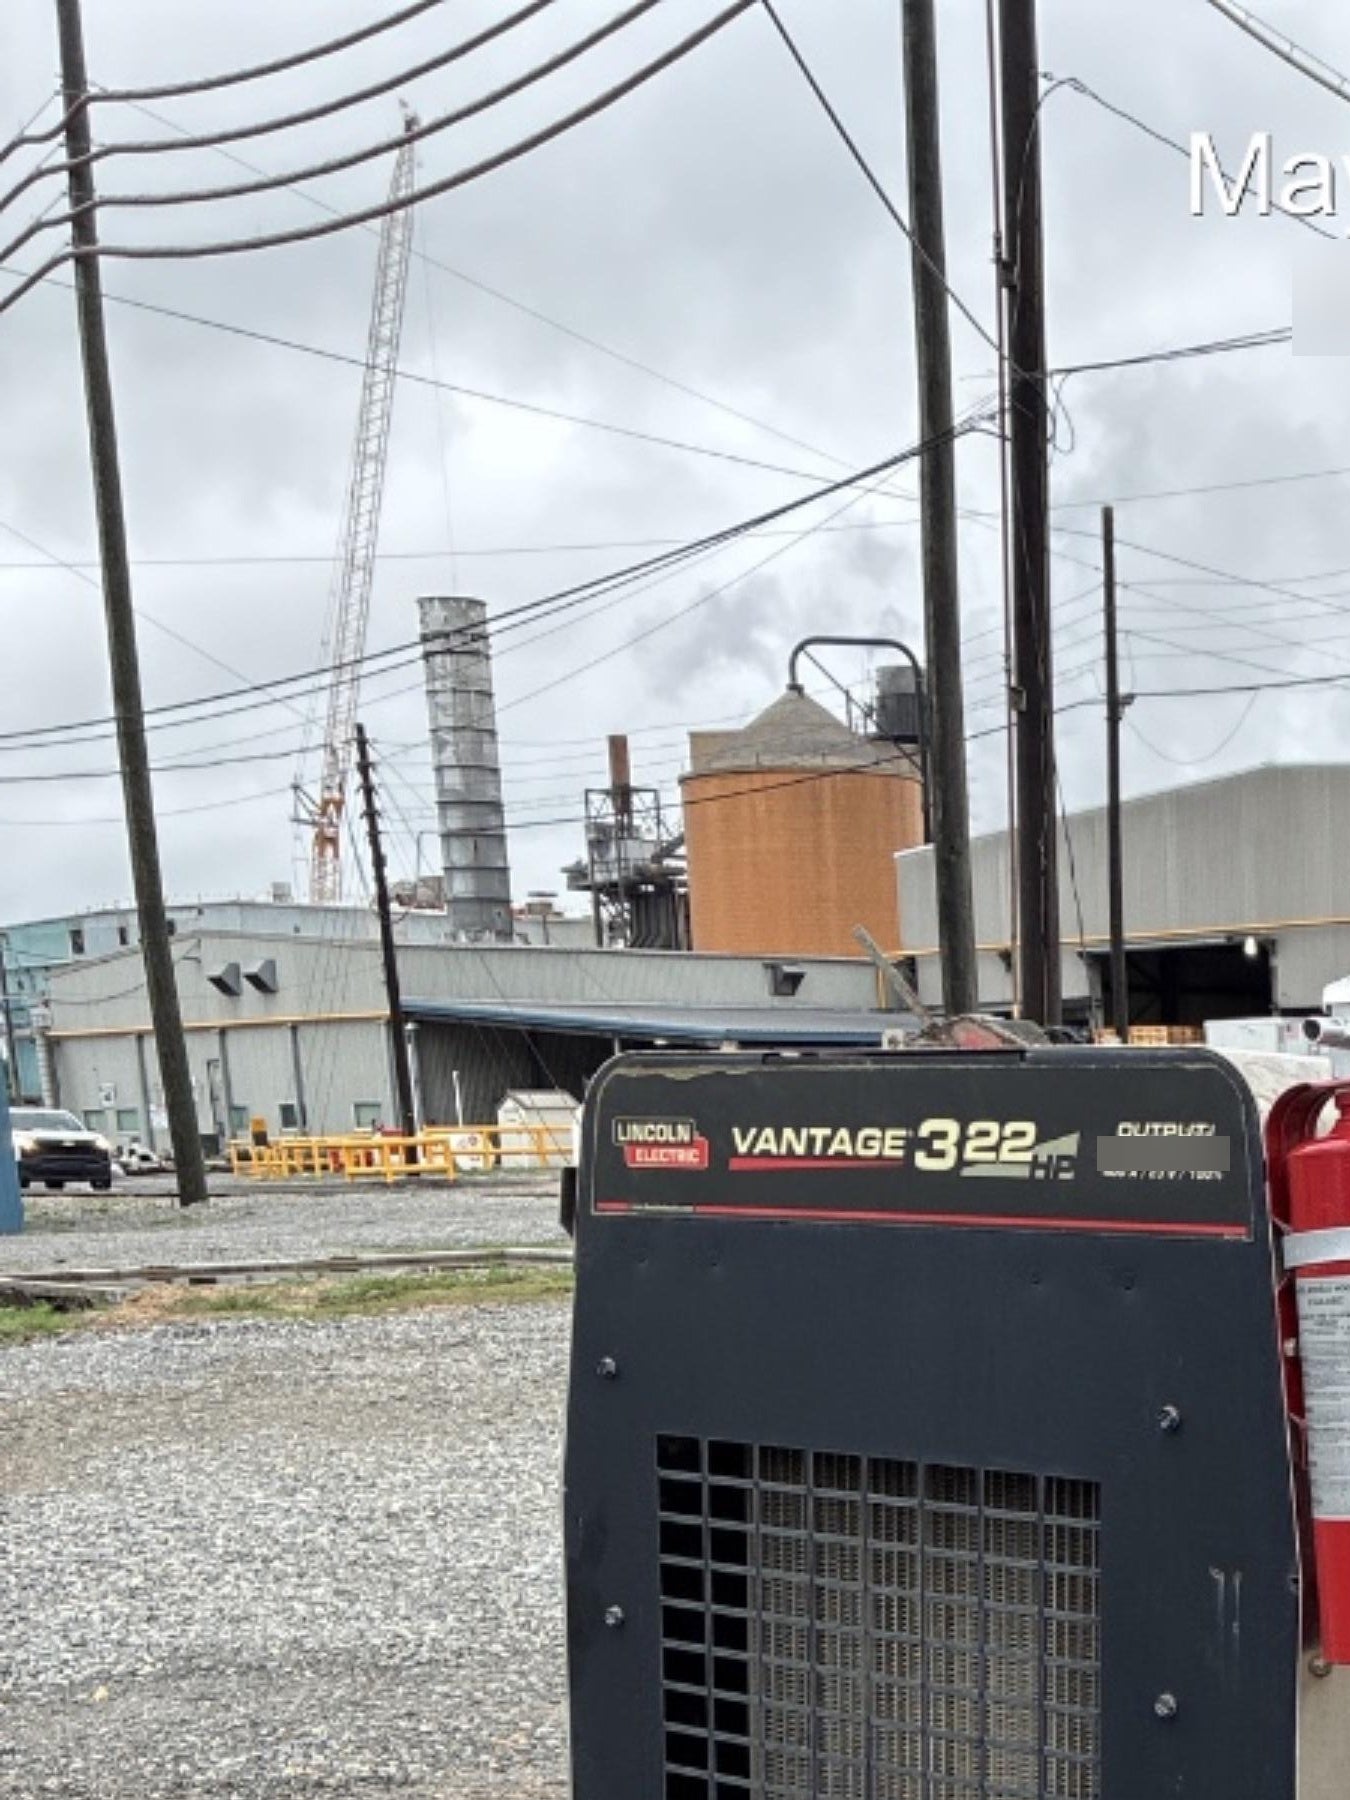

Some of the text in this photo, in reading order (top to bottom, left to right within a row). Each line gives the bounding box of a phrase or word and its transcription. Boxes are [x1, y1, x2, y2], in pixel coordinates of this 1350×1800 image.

[617, 1121, 692, 1143] LINCOLN
[635, 1147, 700, 1163] ELECTRIC
[731, 1126, 908, 1157] VANTAGE
[914, 1117, 1037, 1171] 322
